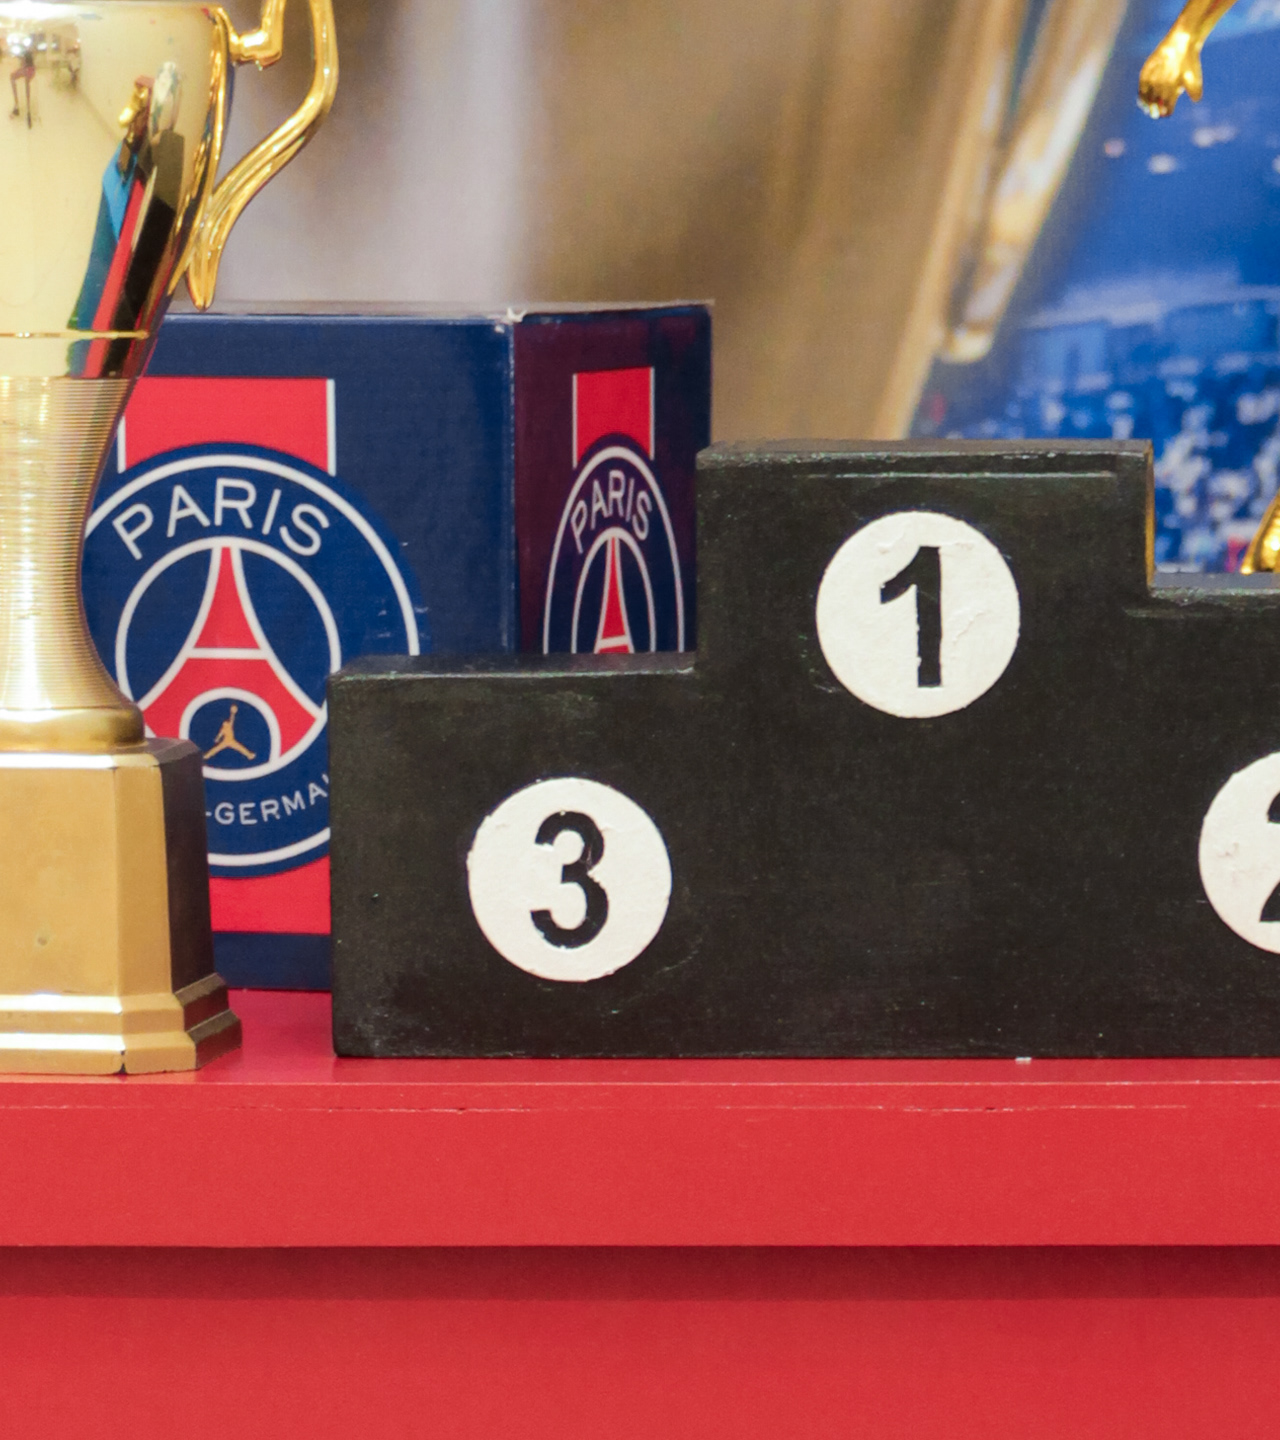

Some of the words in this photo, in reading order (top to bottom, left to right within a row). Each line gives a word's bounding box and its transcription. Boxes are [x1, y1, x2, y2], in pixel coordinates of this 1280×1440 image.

[112, 477, 330, 561] PARIS
[570, 469, 653, 554] PARIS
[879, 544, 944, 690] 1
[204, 773, 330, 826] -GERMA
[529, 809, 611, 951] 3
